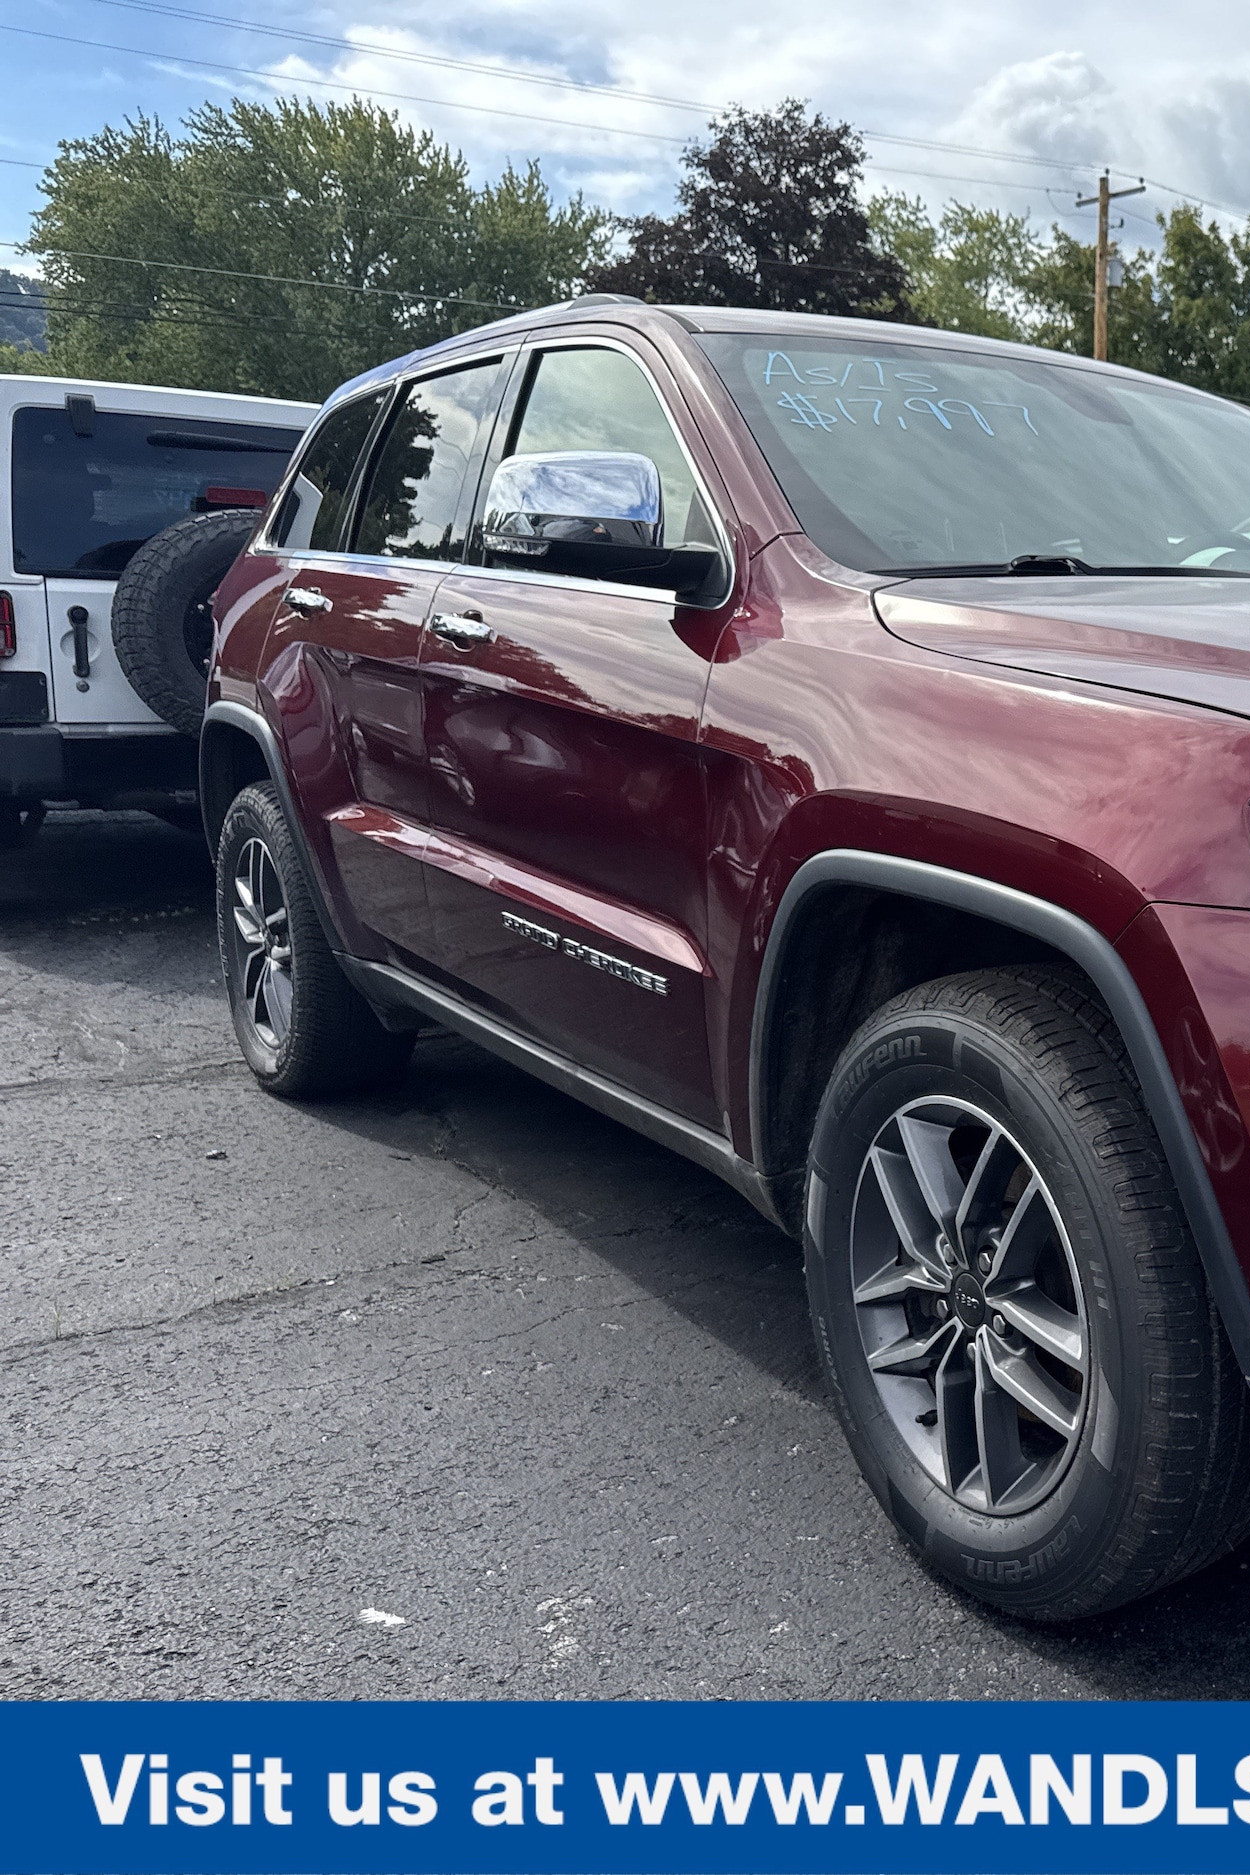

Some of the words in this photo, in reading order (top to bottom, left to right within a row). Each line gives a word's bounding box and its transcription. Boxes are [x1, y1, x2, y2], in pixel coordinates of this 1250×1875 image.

[777, 391, 1038, 436] $17,997
[501, 911, 561, 951] GRAND
[562, 937, 672, 997] CHEROKEE
